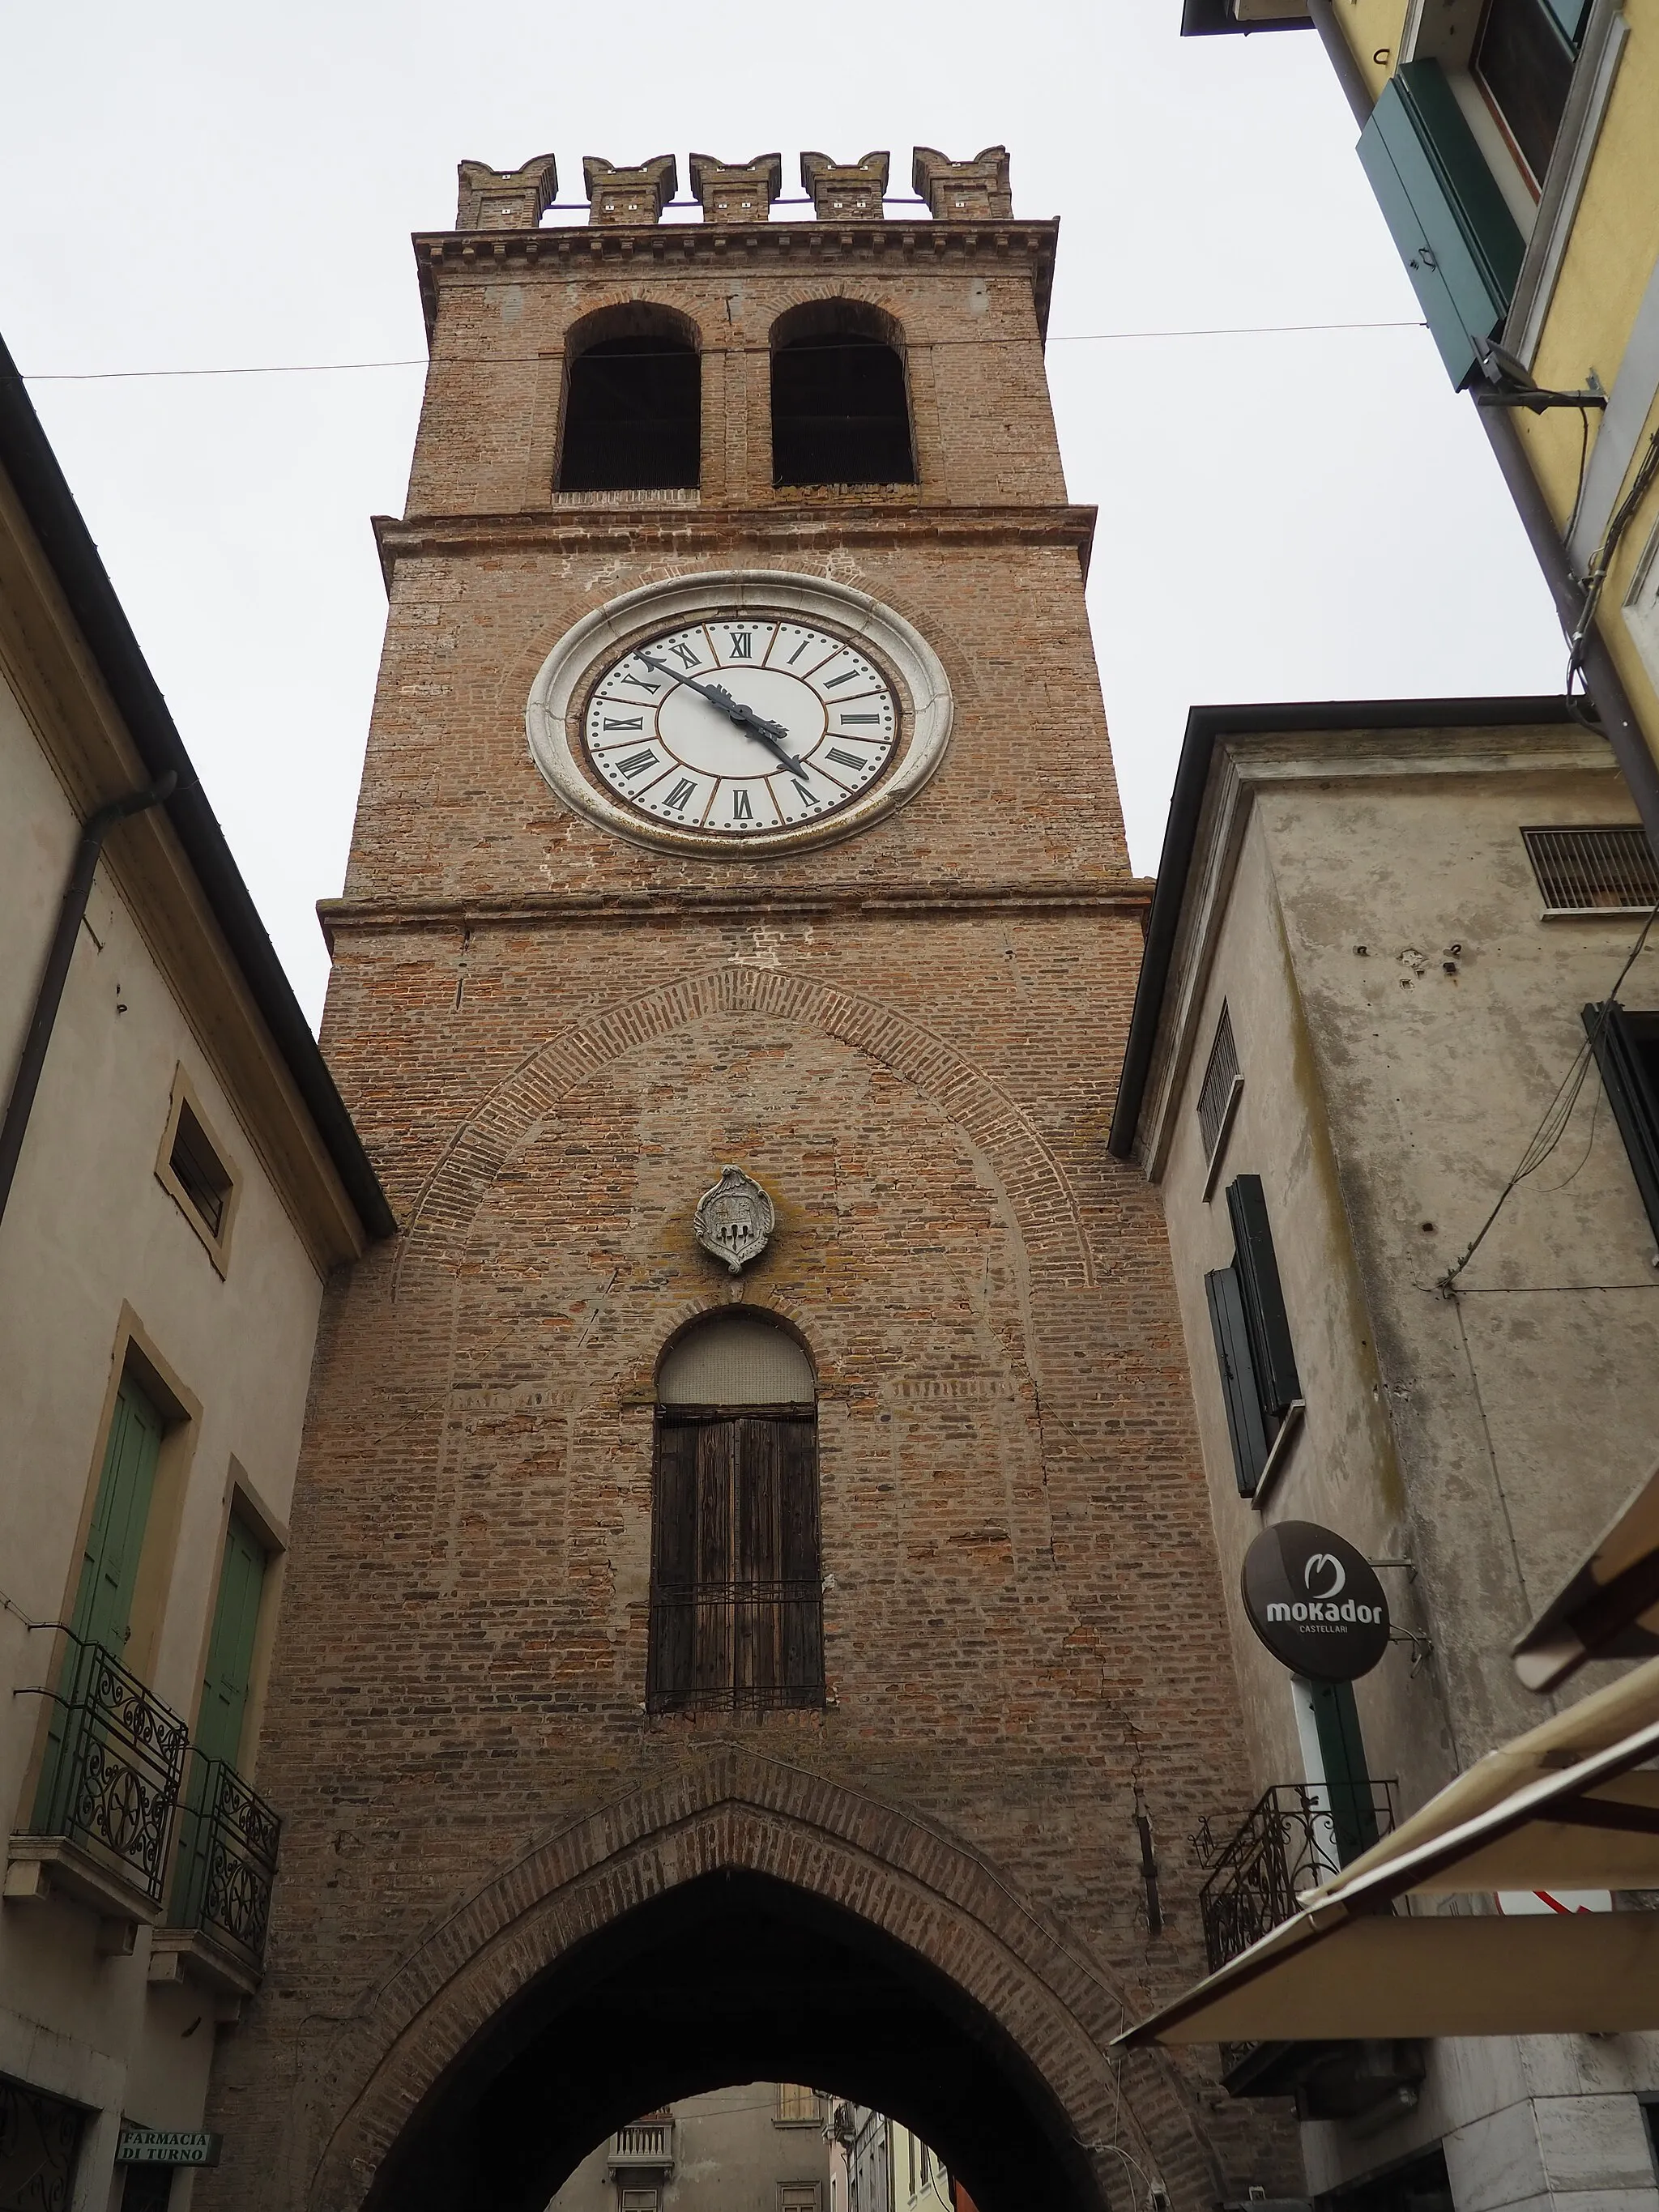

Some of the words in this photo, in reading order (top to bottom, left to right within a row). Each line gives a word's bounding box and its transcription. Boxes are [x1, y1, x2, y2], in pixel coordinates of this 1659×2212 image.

[668, 643, 702, 669] XI
[730, 633, 752, 658] XII
[787, 640, 810, 665] I
[621, 673, 661, 694] X
[823, 669, 860, 689] II
[603, 716, 643, 731] IX
[840, 714, 880, 725] III
[615, 748, 659, 780] VIII
[825, 747, 868, 771] IIII
[662, 778, 698, 811] VII
[732, 790, 753, 820] VI
[791, 778, 821, 808] V
[1267, 1599, 1383, 1624] mokador
[1299, 1625, 1348, 1633] CASTELLARI
[124, 2133, 207, 2145] FARMACIA
[122, 2148, 141, 2159] DI
[147, 2148, 203, 2160] TURNO
